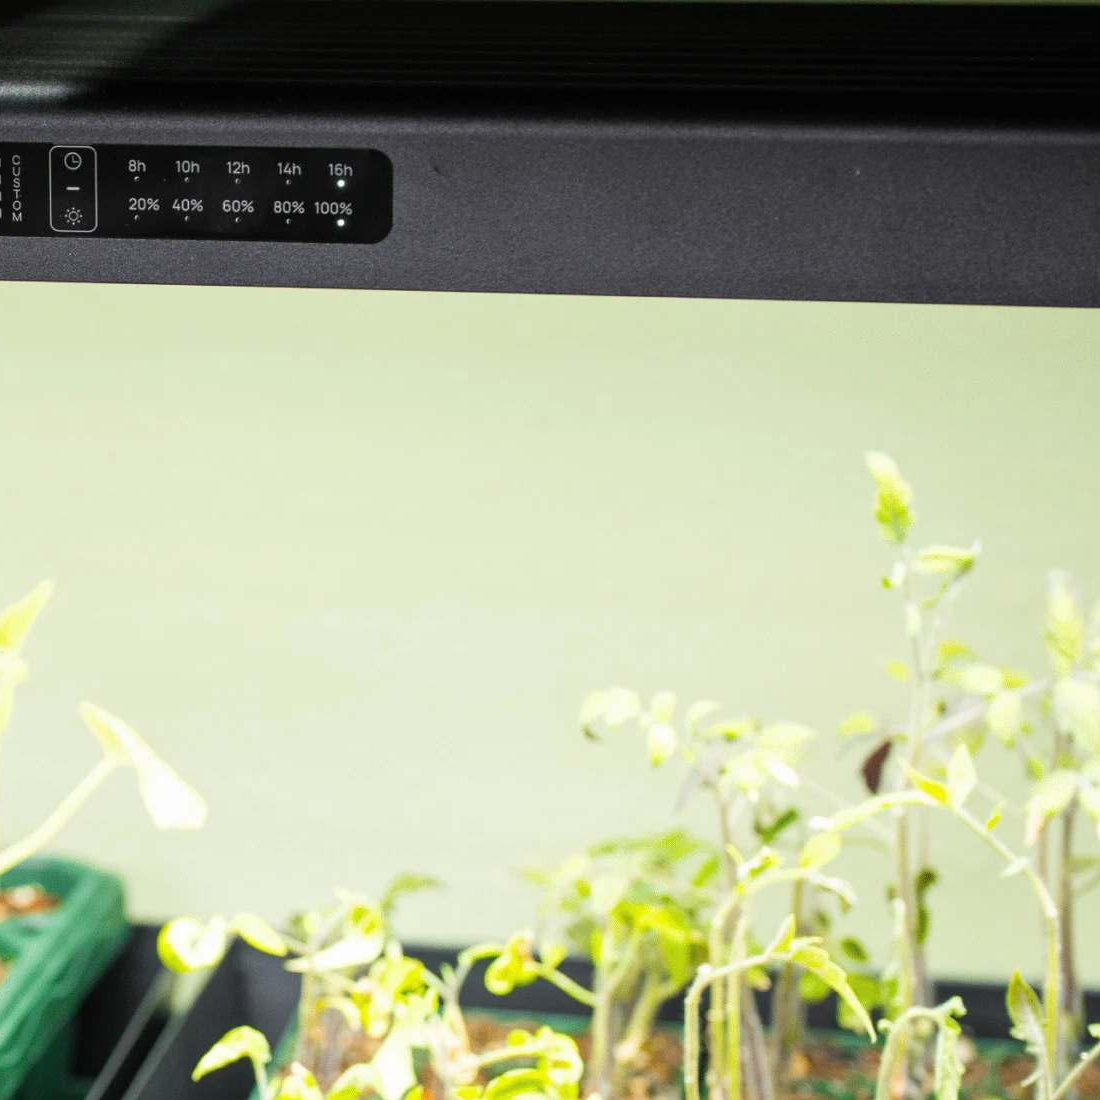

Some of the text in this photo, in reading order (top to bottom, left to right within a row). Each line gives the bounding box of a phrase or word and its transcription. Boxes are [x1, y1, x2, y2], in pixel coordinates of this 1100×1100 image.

[128, 159, 353, 178] 8h 10h 12h 14h 16h
[128, 198, 353, 216] 20% 40% 60% 80% 100%
